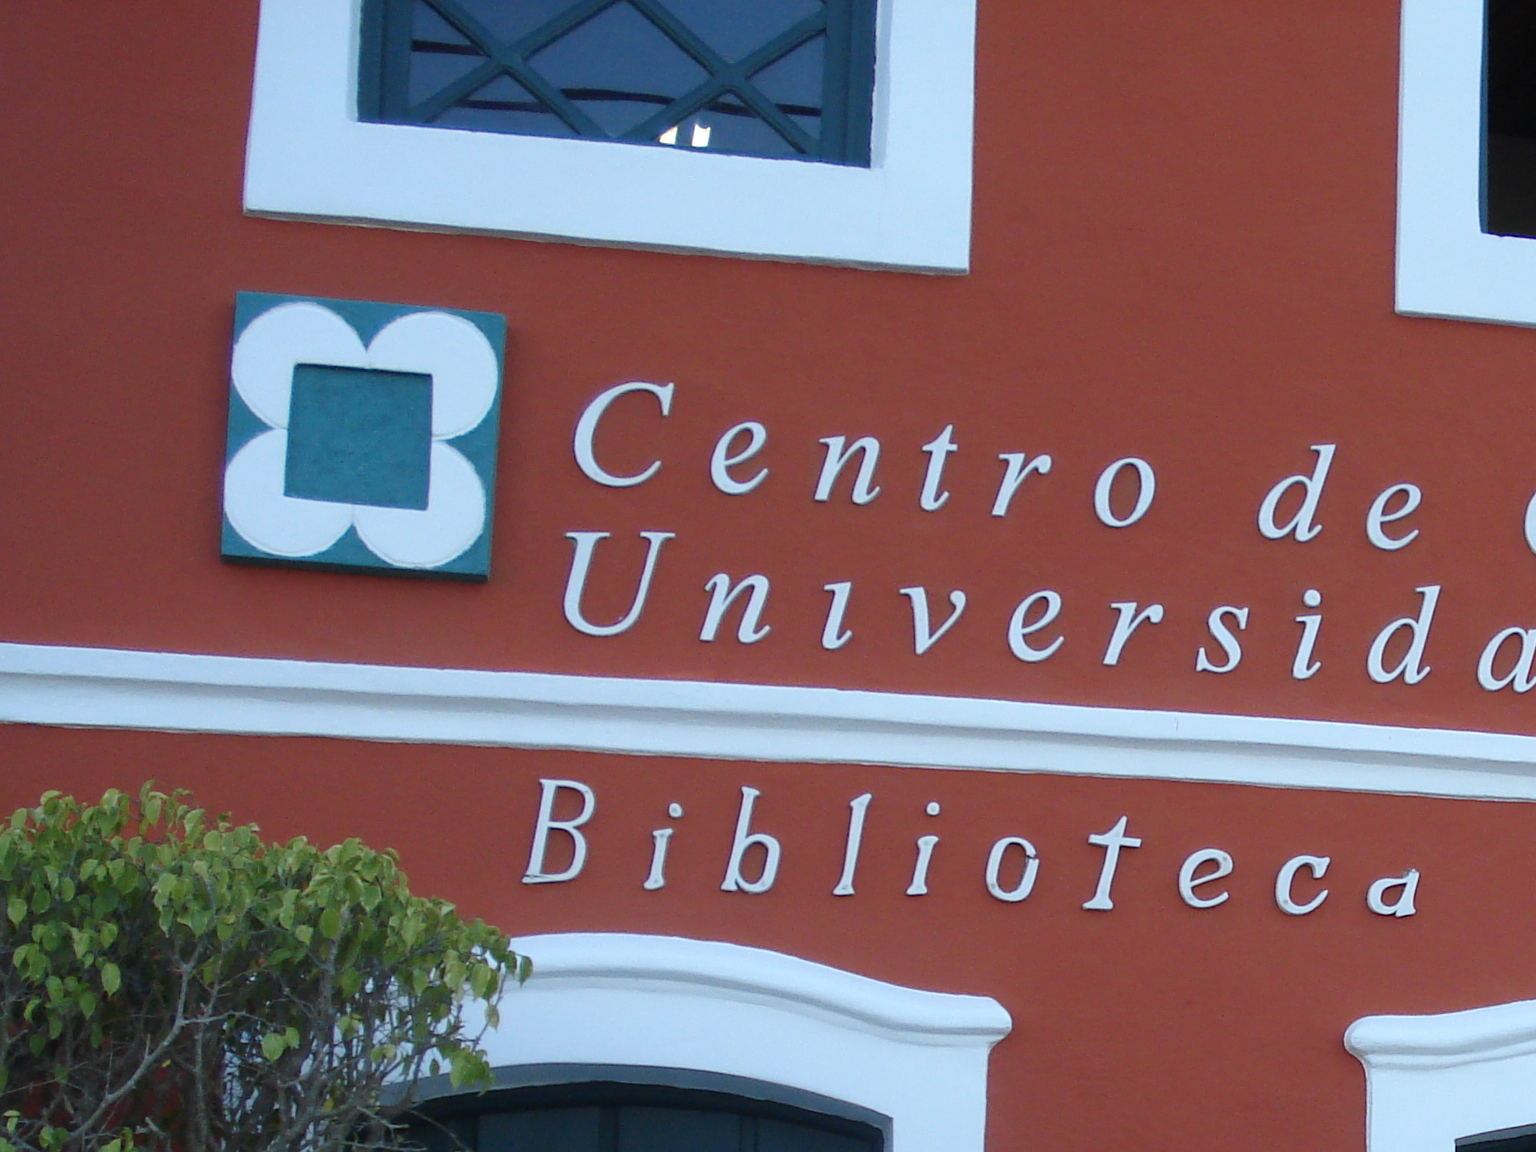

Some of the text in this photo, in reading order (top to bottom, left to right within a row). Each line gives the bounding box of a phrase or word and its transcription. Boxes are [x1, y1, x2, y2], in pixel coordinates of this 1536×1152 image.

[572, 380, 1157, 530] Centro
[1257, 442, 1424, 552] de
[520, 777, 1422, 919] Biblioteca
